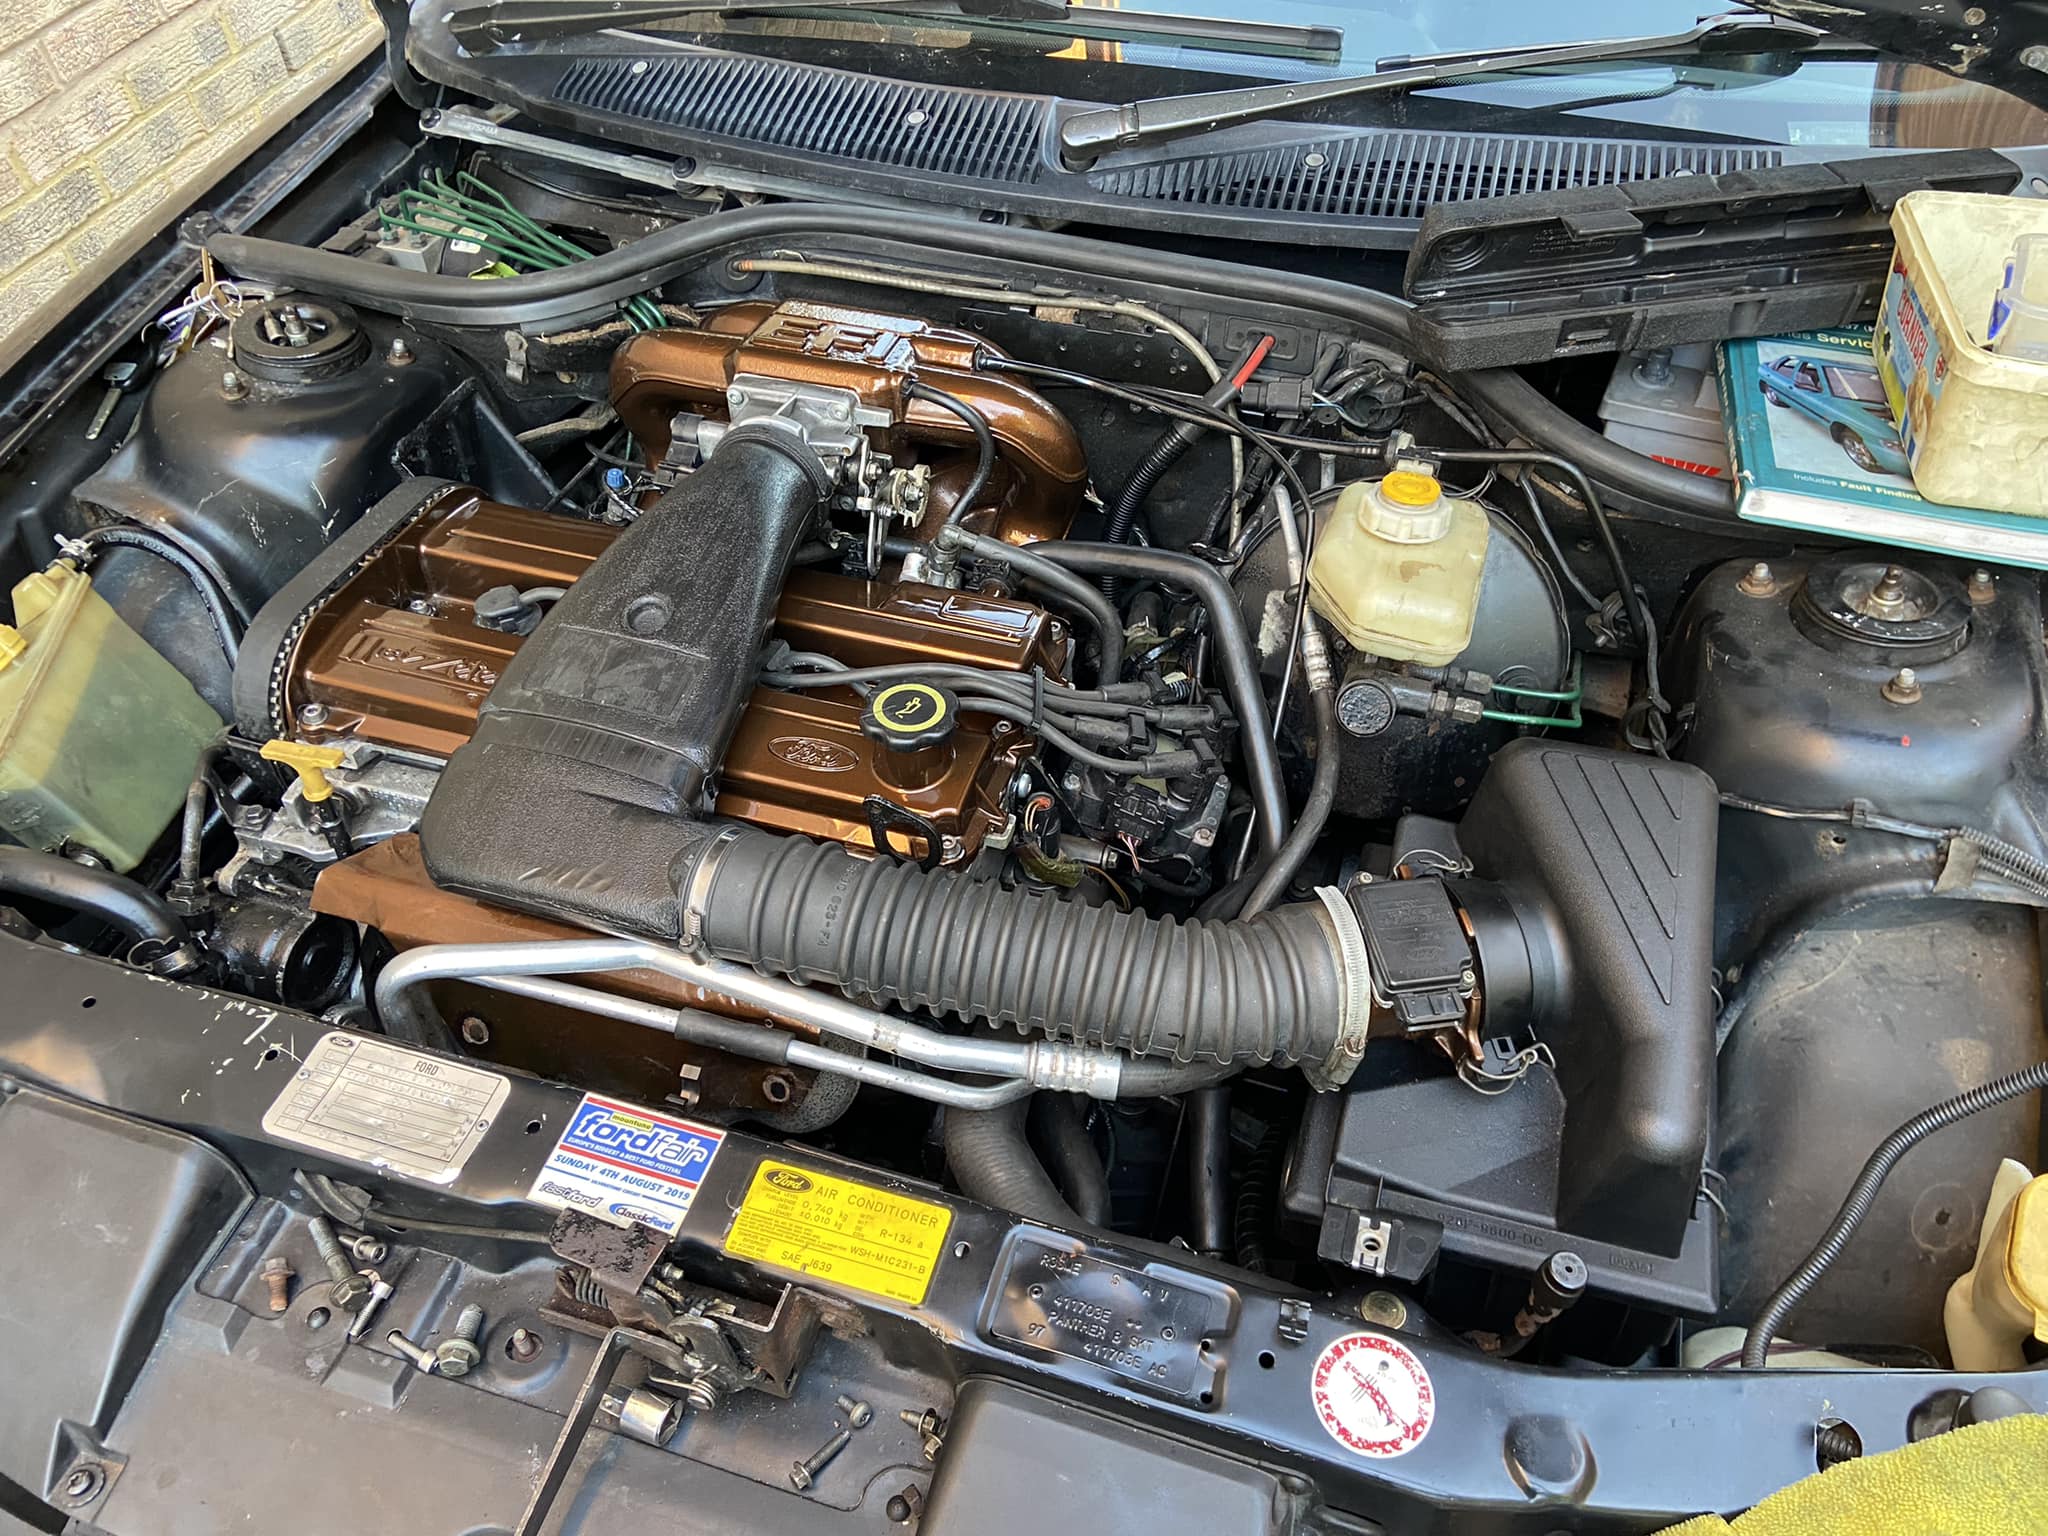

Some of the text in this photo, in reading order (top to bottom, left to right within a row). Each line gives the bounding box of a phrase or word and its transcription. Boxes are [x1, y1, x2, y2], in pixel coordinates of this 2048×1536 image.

[750, 313, 901, 366] EFI
[1896, 289, 1929, 370] CORNISH
[1817, 333, 1874, 350] Servic
[1793, 473, 1922, 501] Includes Fault Finding
[414, 1060, 439, 1077] FORD
[554, 1154, 598, 1172] SUNDAY
[599, 1168, 620, 1180] 4TH
[620, 1174, 664, 1193] AUGUST
[664, 1186, 691, 1201] 2019
[773, 1170, 805, 1191] Ford
[815, 1186, 839, 1201] AIR
[848, 1194, 939, 1229] CONDITIONER
[839, 1208, 849, 1222] kg
[880, 1229, 912, 1246] R-134
[780, 1250, 801, 1264] SAE
[1028, 1322, 1046, 1338] 97
[1048, 1311, 1106, 1340] PANTHER
